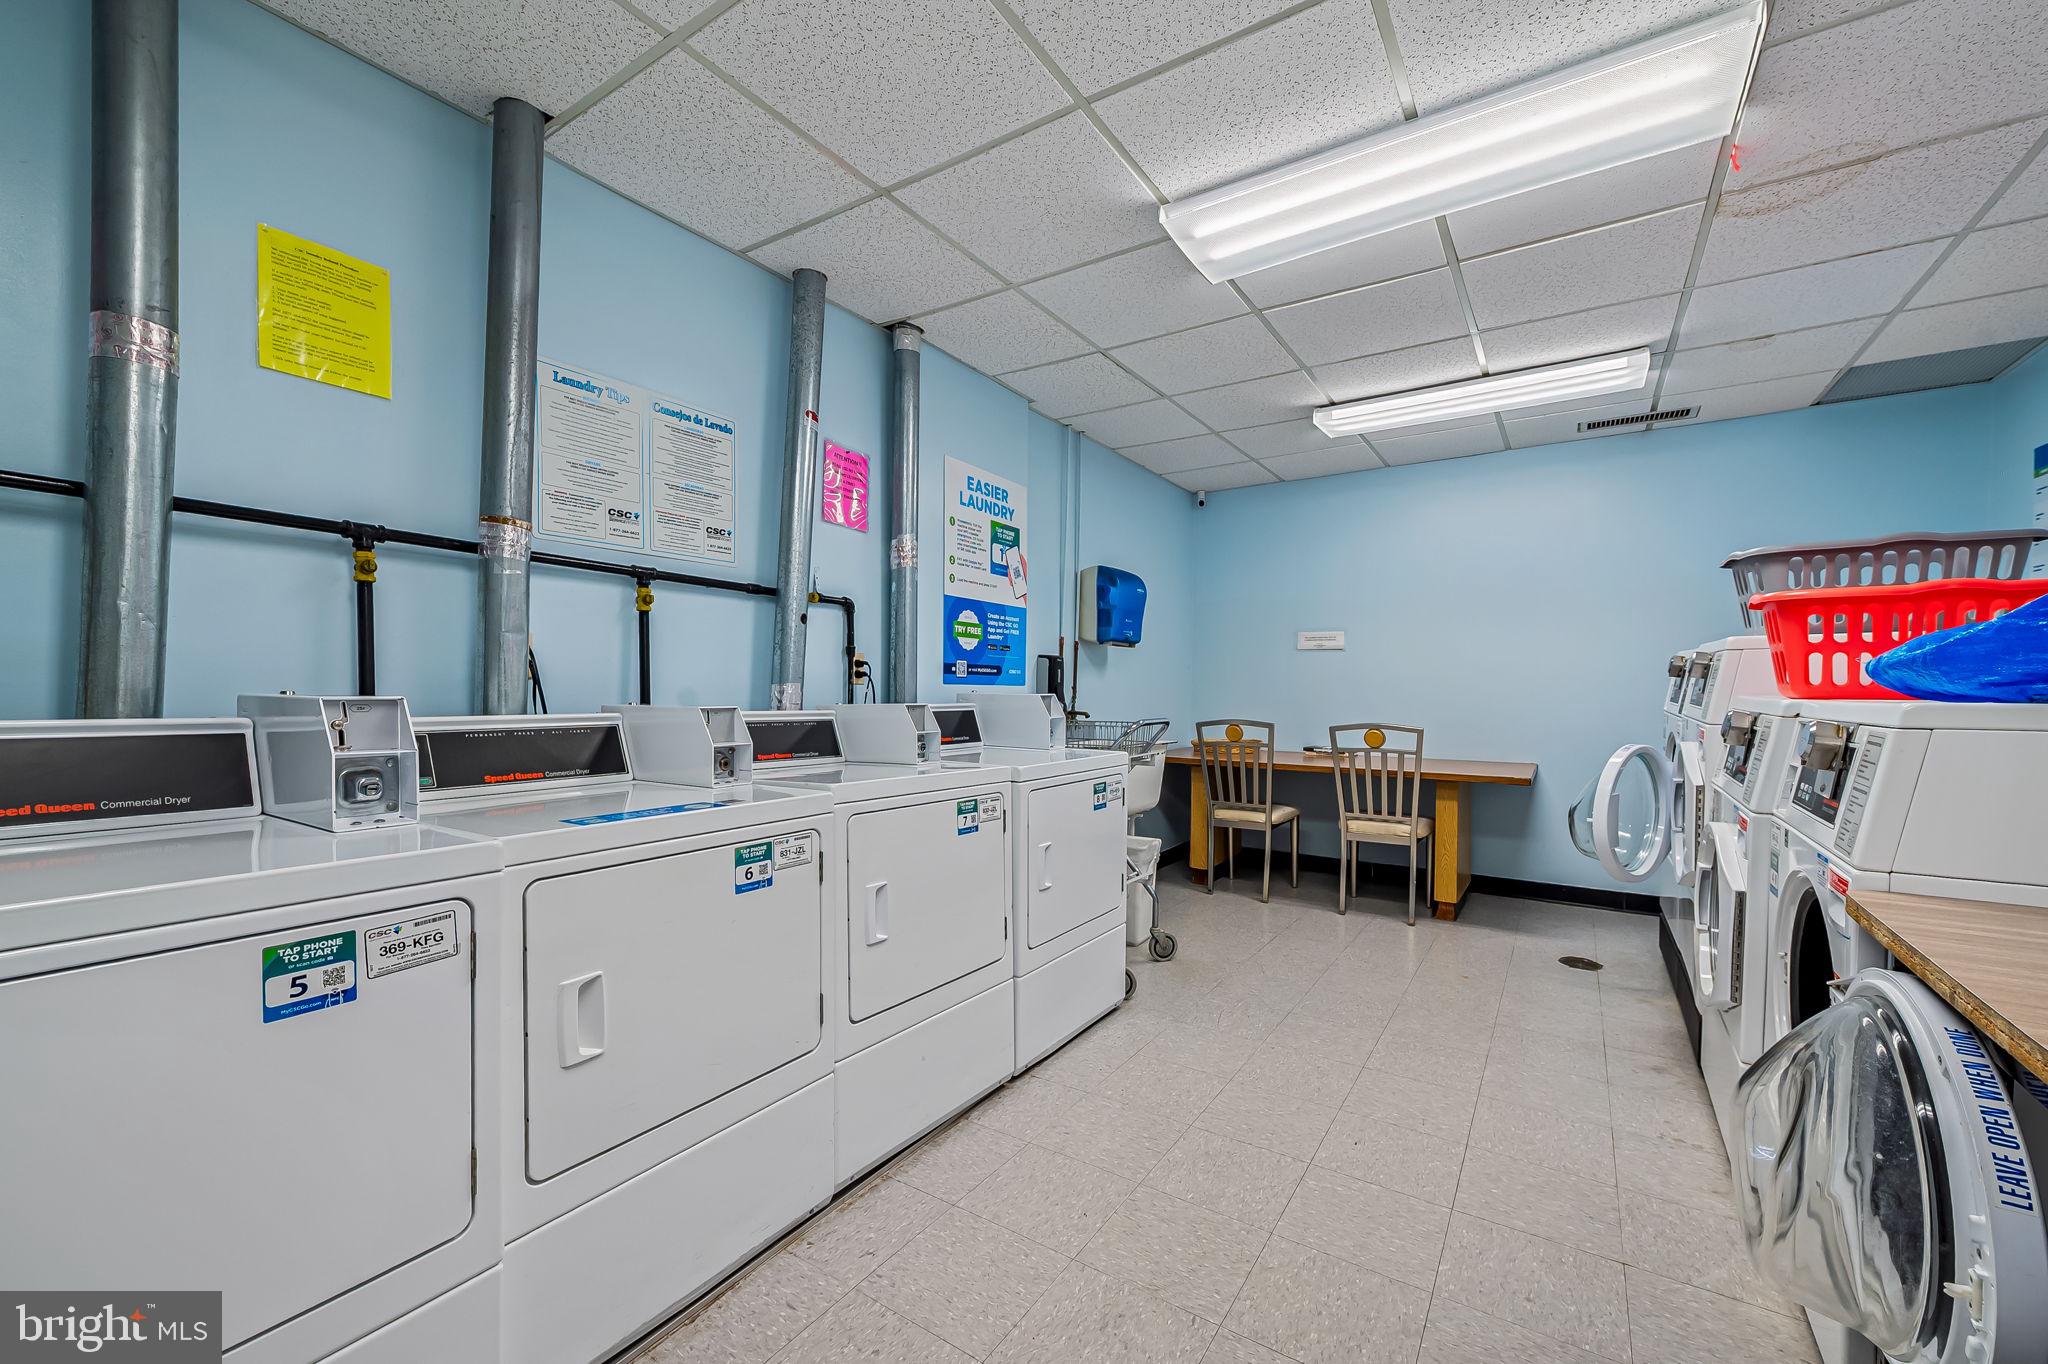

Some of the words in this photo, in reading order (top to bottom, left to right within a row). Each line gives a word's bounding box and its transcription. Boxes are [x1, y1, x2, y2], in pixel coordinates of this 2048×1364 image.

[552, 370, 604, 398] Laundry
[605, 386, 630, 405] Tips
[653, 402, 692, 422] Consejos
[692, 414, 704, 426] de
[704, 417, 734, 435] Lavado
[966, 475, 1009, 504] EASIER
[608, 508, 633, 519] CSC
[960, 490, 1015, 522] LAUNDRY
[706, 526, 726, 536] CSC
[954, 625, 966, 634] TRY
[967, 626, 982, 635] FREE
[484, 773, 514, 783] Speed
[515, 772, 544, 780] Queen
[545, 770, 575, 778] Commercial
[34, 802, 95, 814] Queen
[100, 796, 162, 810] Commercial
[164, 795, 192, 806] Dryer
[963, 816, 968, 826] 7
[745, 866, 753, 880] 6
[368, 928, 392, 940] CSC
[379, 932, 444, 957] 369-KFG
[278, 946, 300, 957] TAP
[304, 937, 343, 952] PHONE
[283, 955, 299, 964] TO
[302, 946, 338, 960] START
[289, 974, 308, 998] 5
[1943, 1026, 1986, 1059] DONE
[1961, 1060, 2005, 1102] WHEN
[1978, 1104, 2020, 1150] OPEN
[1991, 1152, 2034, 1212] LEAVE
